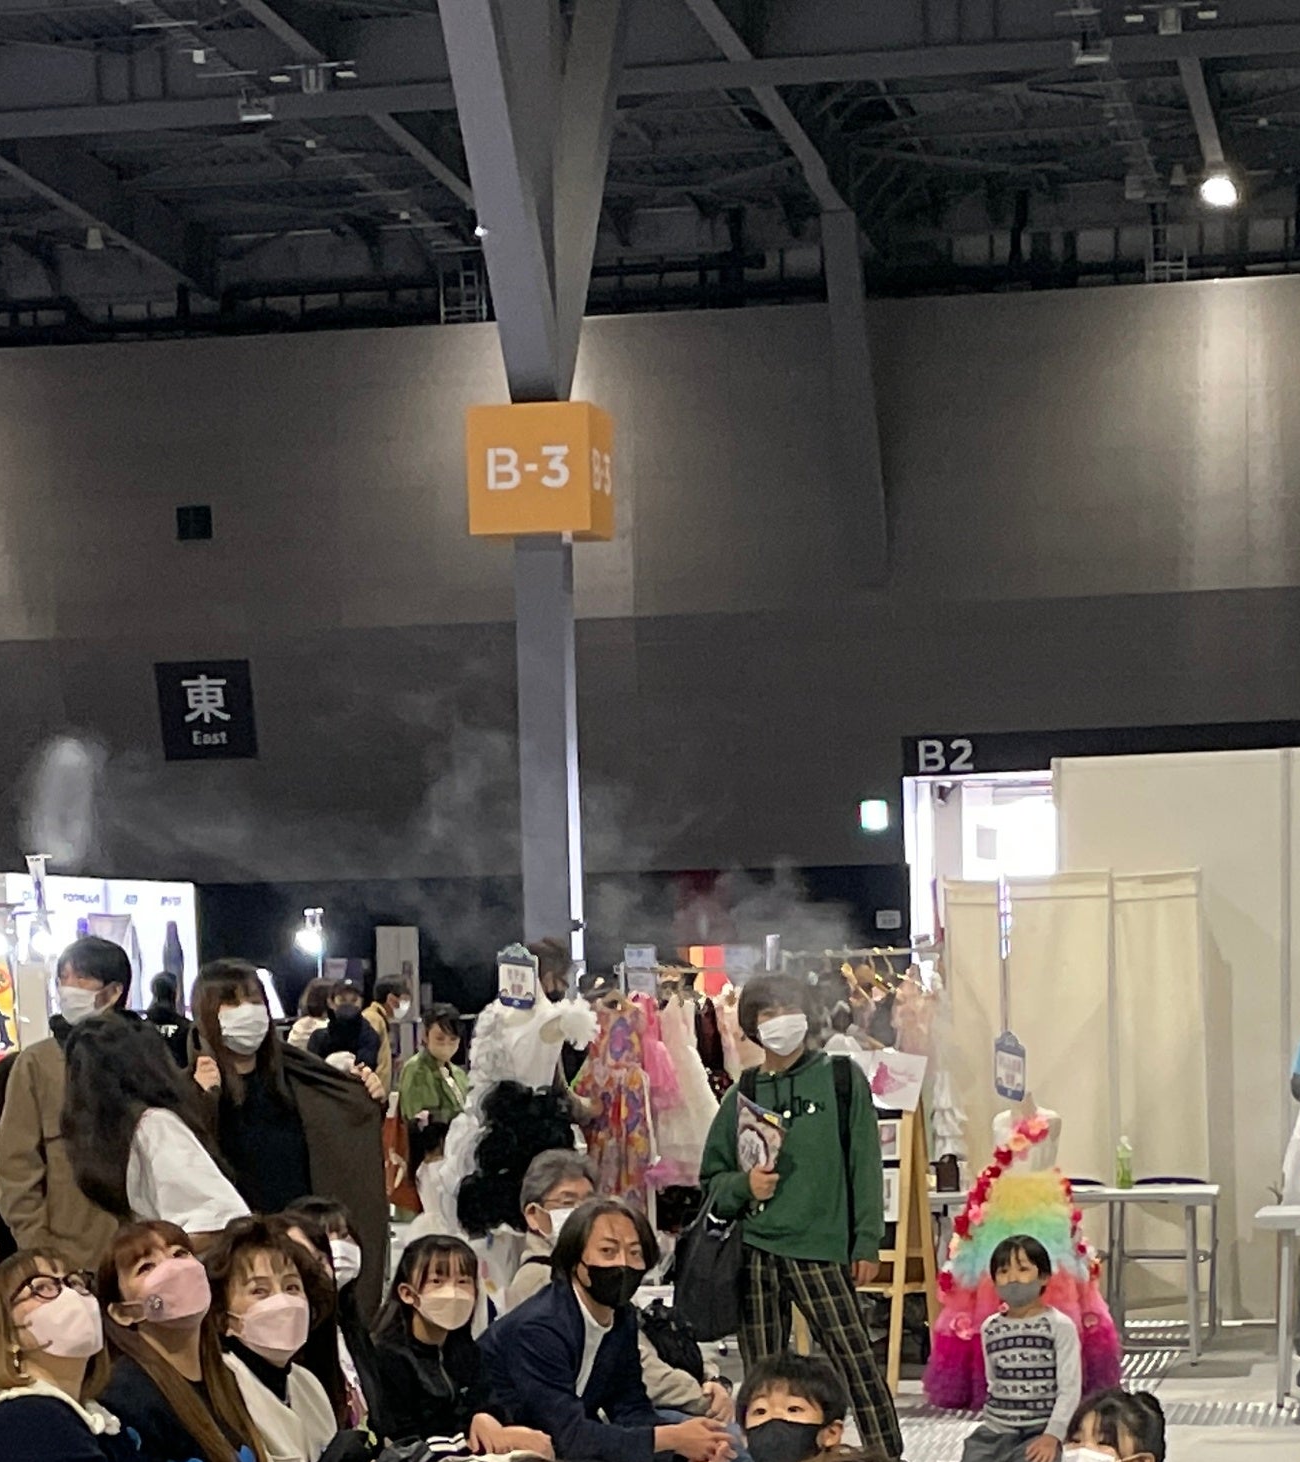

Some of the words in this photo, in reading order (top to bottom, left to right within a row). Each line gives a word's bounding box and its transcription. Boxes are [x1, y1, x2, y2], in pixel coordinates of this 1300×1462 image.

[486, 445, 570, 490] B-3
[591, 446, 612, 496] B-3
[181, 673, 232, 724] 東
[192, 729, 227, 747] East
[916, 738, 975, 773] B2
